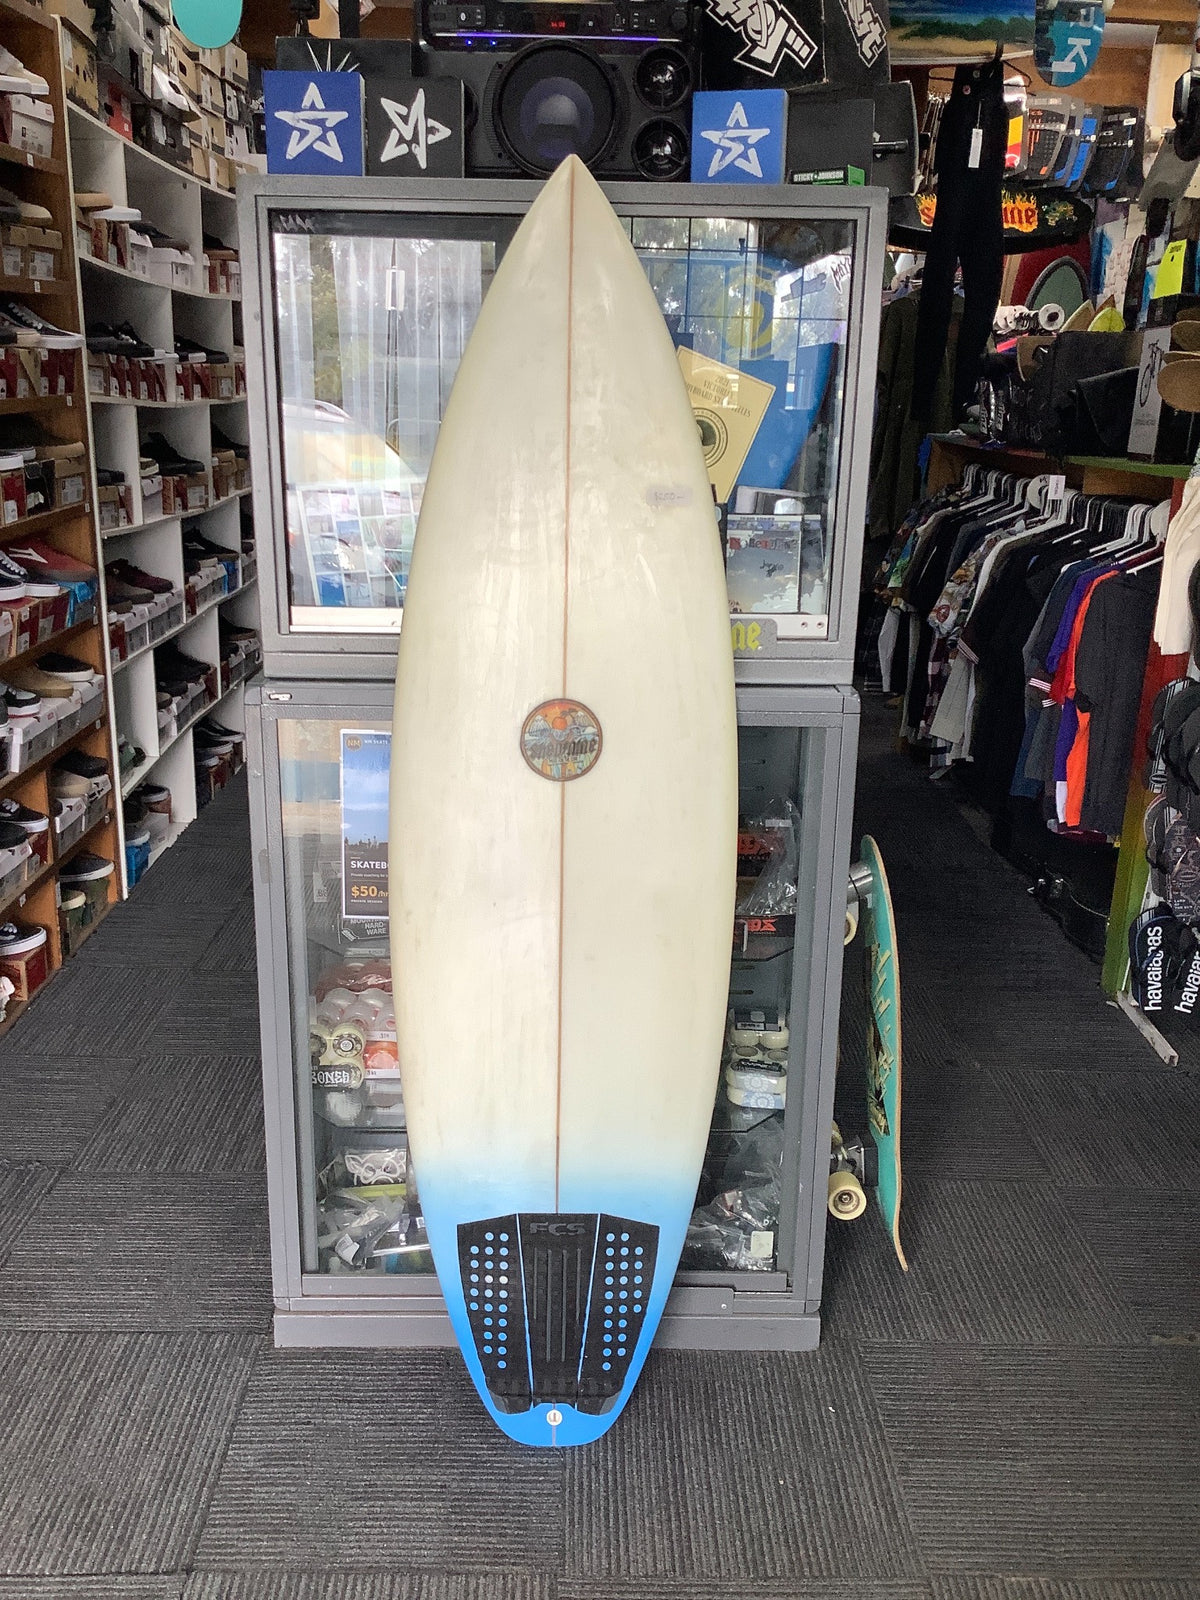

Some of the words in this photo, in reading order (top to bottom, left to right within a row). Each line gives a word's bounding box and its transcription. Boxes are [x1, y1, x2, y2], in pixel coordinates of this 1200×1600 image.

[731, 621, 761, 651] ne
[350, 860, 388, 869] SKATEB
[529, 1222, 586, 1236] FCS
